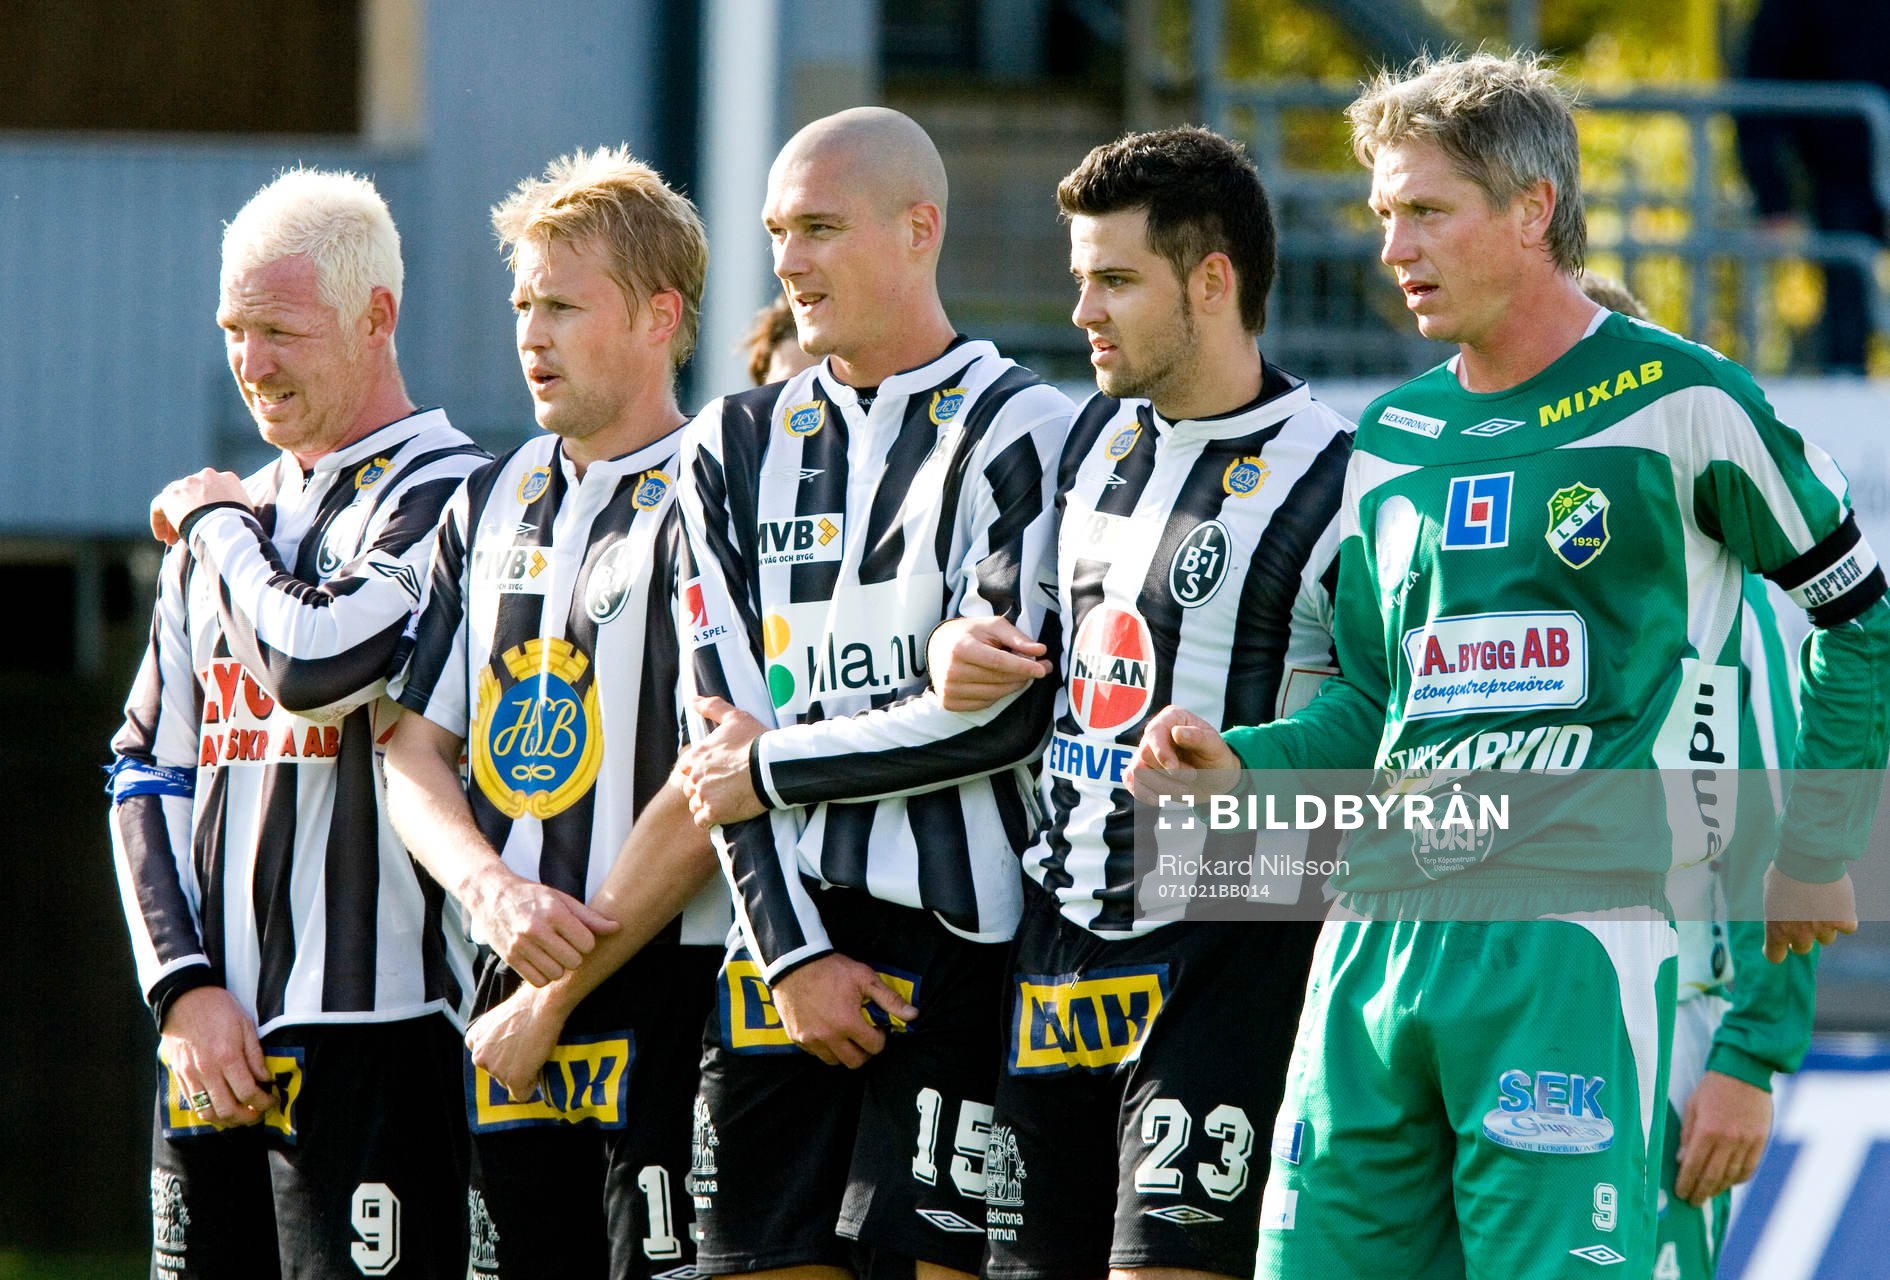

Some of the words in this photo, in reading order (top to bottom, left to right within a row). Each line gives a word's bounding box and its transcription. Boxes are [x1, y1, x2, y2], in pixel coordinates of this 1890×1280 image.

[1538, 360, 1663, 428] MIXAB
[1382, 411, 1431, 432] HEXATRONIC
[779, 555, 794, 563] OCH
[796, 553, 814, 562] BYGG
[1572, 536, 1601, 547] 1926
[1803, 555, 1863, 607] CAPTAIN
[702, 625, 728, 640] SPEL
[1458, 639, 1516, 673] BYGG
[1520, 627, 1570, 669] AB
[1413, 676, 1565, 704] etongentreprenören
[302, 725, 339, 759] AB
[1422, 857, 1437, 865] Torp
[1433, 864, 1465, 872] Uddevalla
[1498, 1069, 1607, 1120] SEK
[911, 1086, 995, 1200] 15
[1134, 1098, 1256, 1202] 23
[350, 1182, 401, 1277] 9
[637, 1164, 690, 1262] 1
[1591, 1182, 1619, 1233] 9
